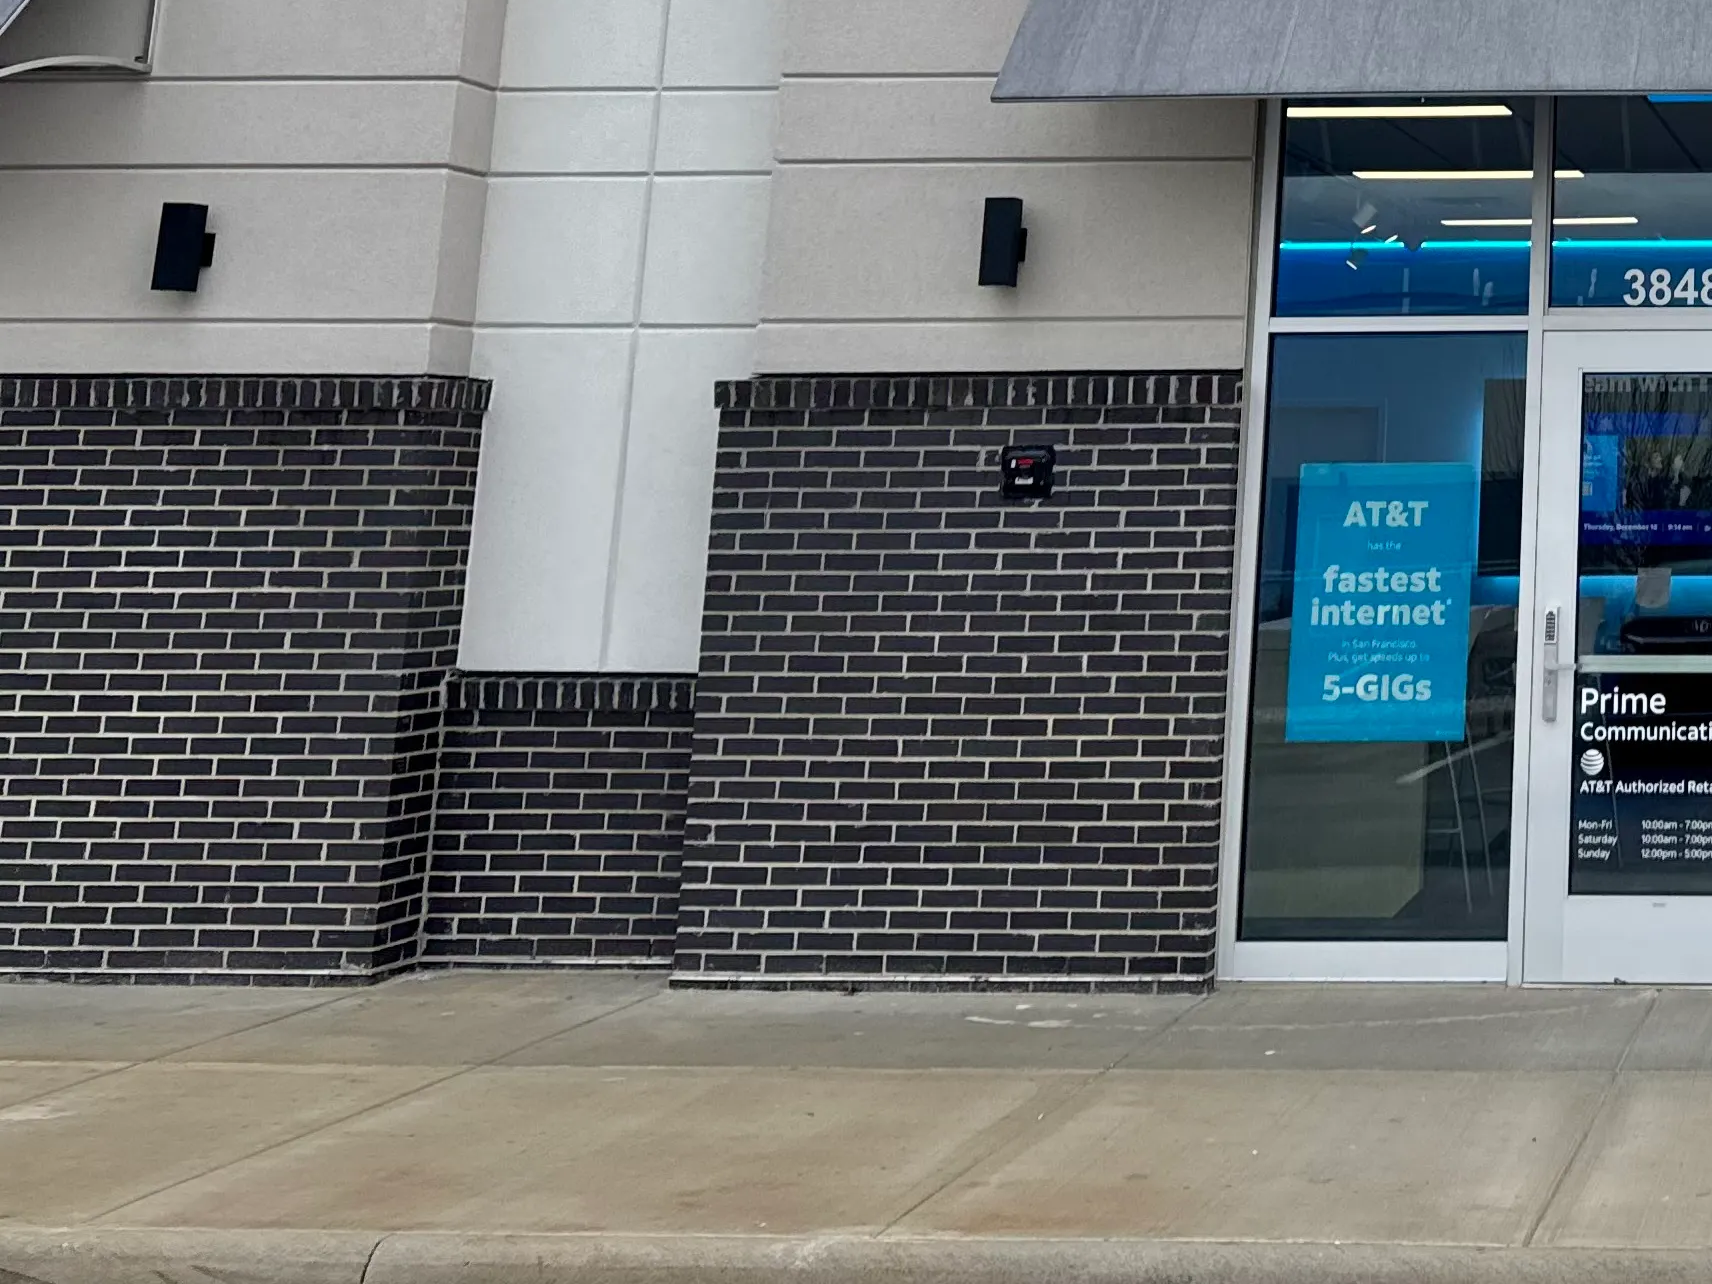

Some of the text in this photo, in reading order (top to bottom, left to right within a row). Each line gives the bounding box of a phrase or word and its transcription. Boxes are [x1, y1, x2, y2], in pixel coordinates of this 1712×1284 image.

[1343, 501, 1429, 527] AT&T
[1367, 539, 1402, 550] has the
[1323, 565, 1442, 593] fastest
[1322, 673, 1432, 701] 5-GIGs
[1580, 686, 1666, 714] Prime
[1580, 780, 1613, 794] AT&T
[1615, 779, 1684, 794] Authorized
[1578, 833, 1618, 846] Saturday
[1577, 848, 1611, 861] Sunday
